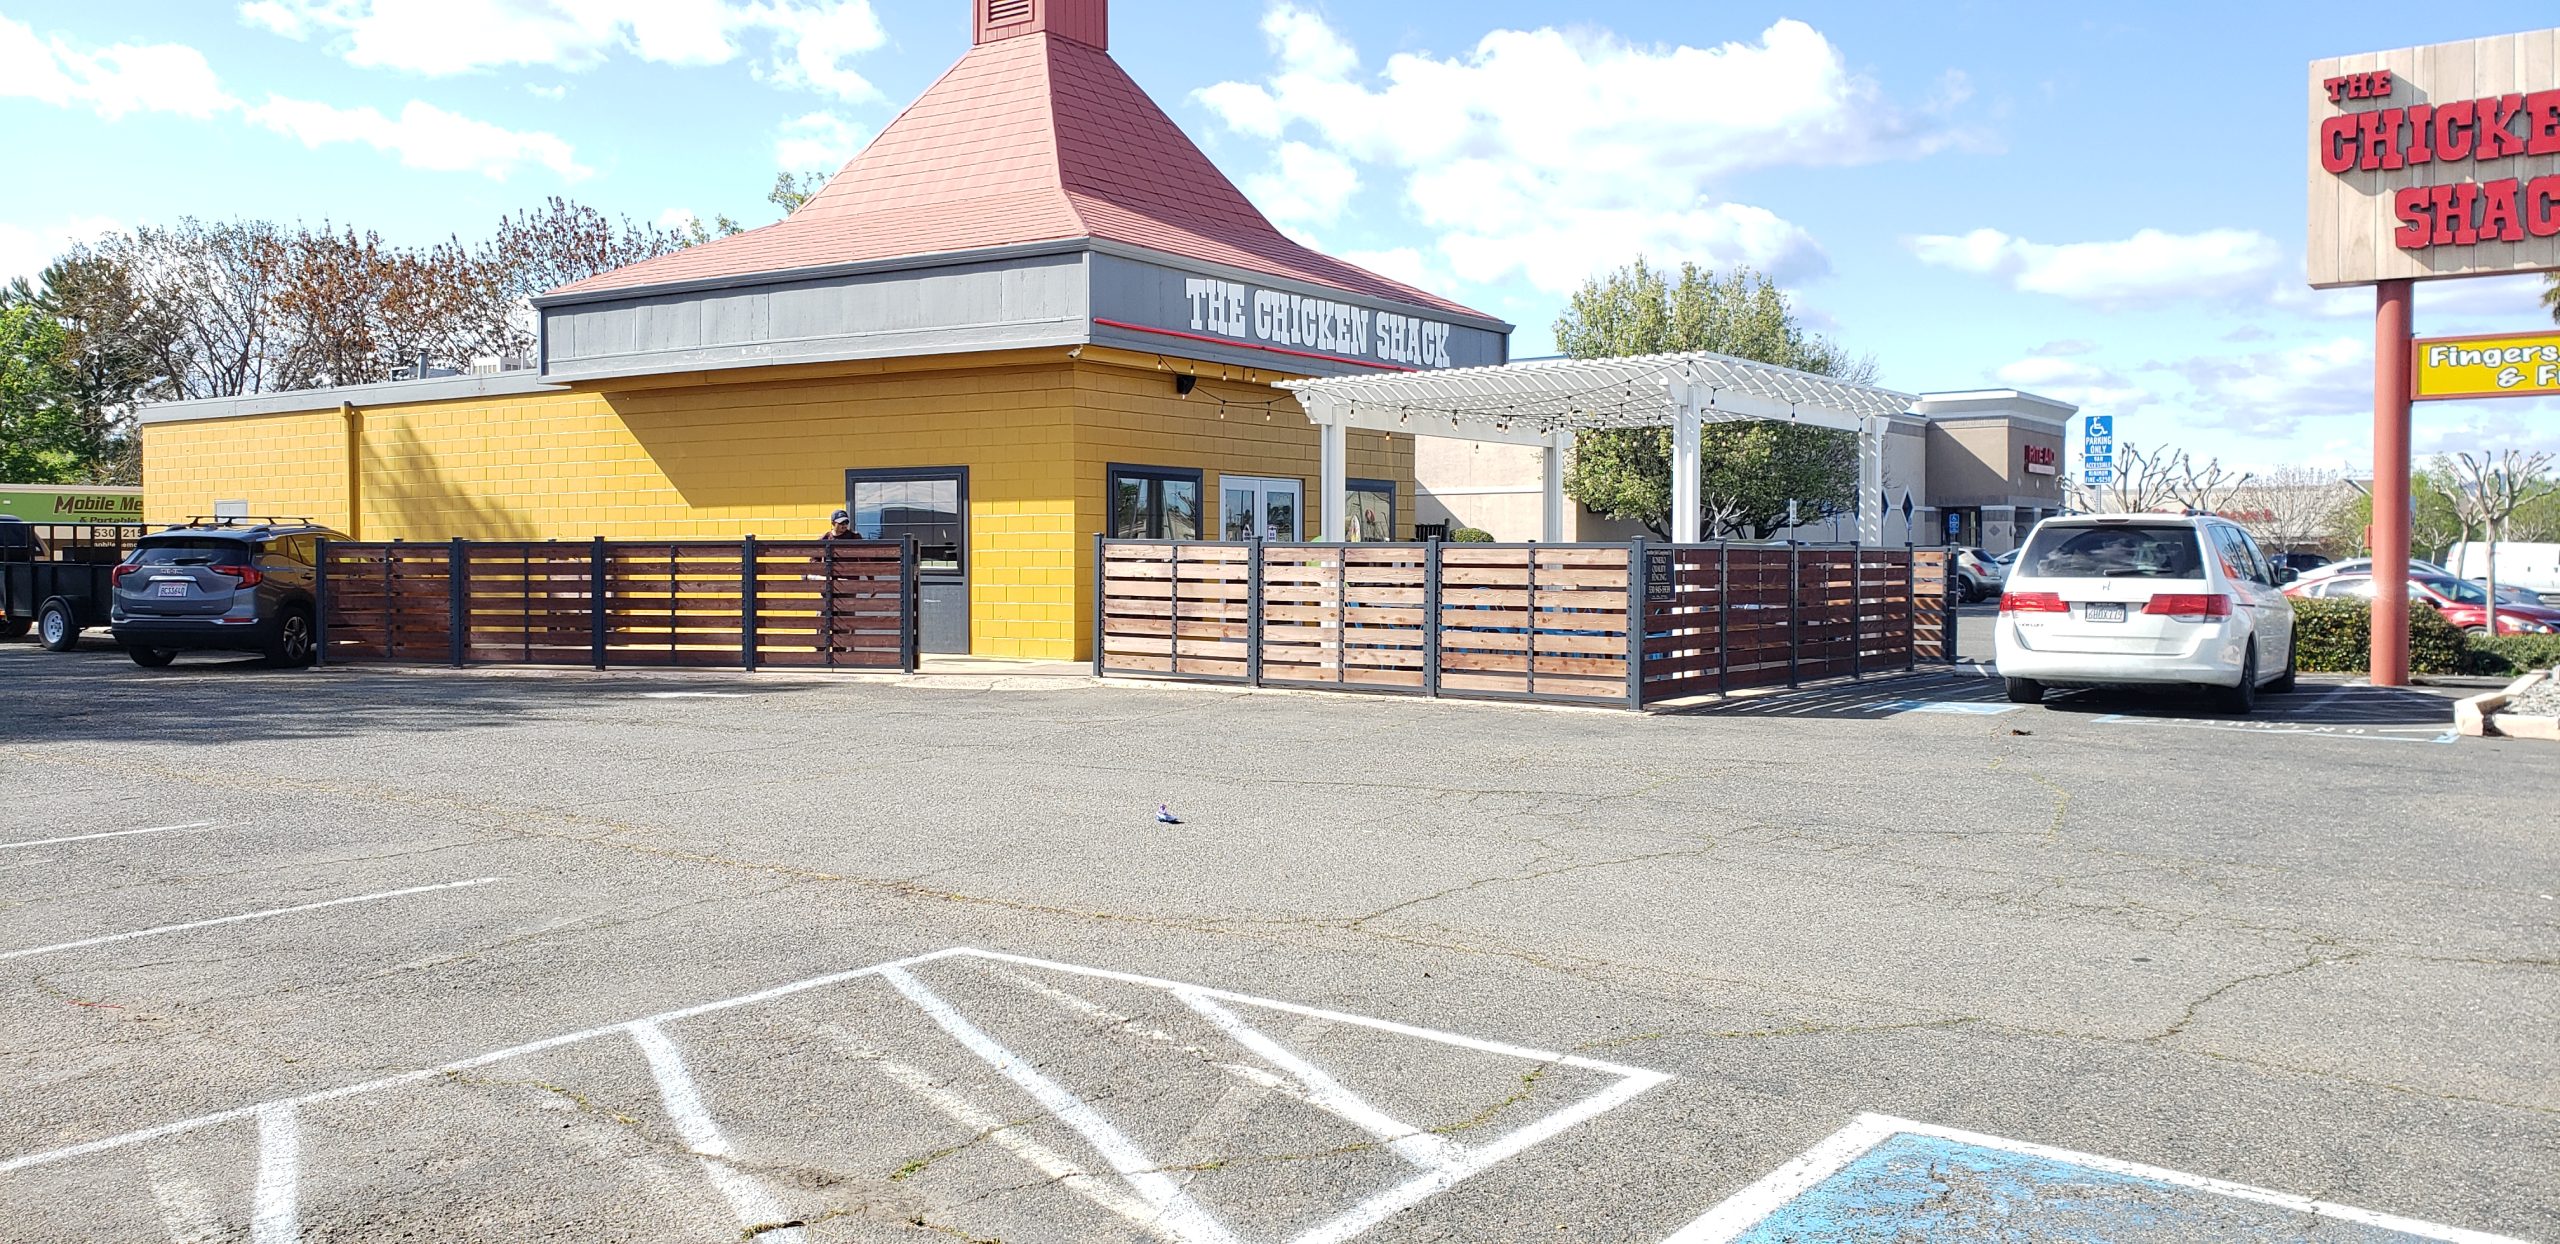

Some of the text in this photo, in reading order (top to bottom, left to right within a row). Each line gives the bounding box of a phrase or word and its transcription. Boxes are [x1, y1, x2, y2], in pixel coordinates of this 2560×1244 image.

[2323, 69, 2392, 102] THE
[2320, 89, 2560, 175] CHICKE
[2394, 174, 2560, 250] SHAC
[1185, 278, 1451, 369] THE CHICKEN SHACK
[2497, 366, 2527, 388] &
[2085, 436, 2112, 446] PARKING
[2090, 445, 2107, 454] ONLY
[54, 496, 115, 515] Mobile
